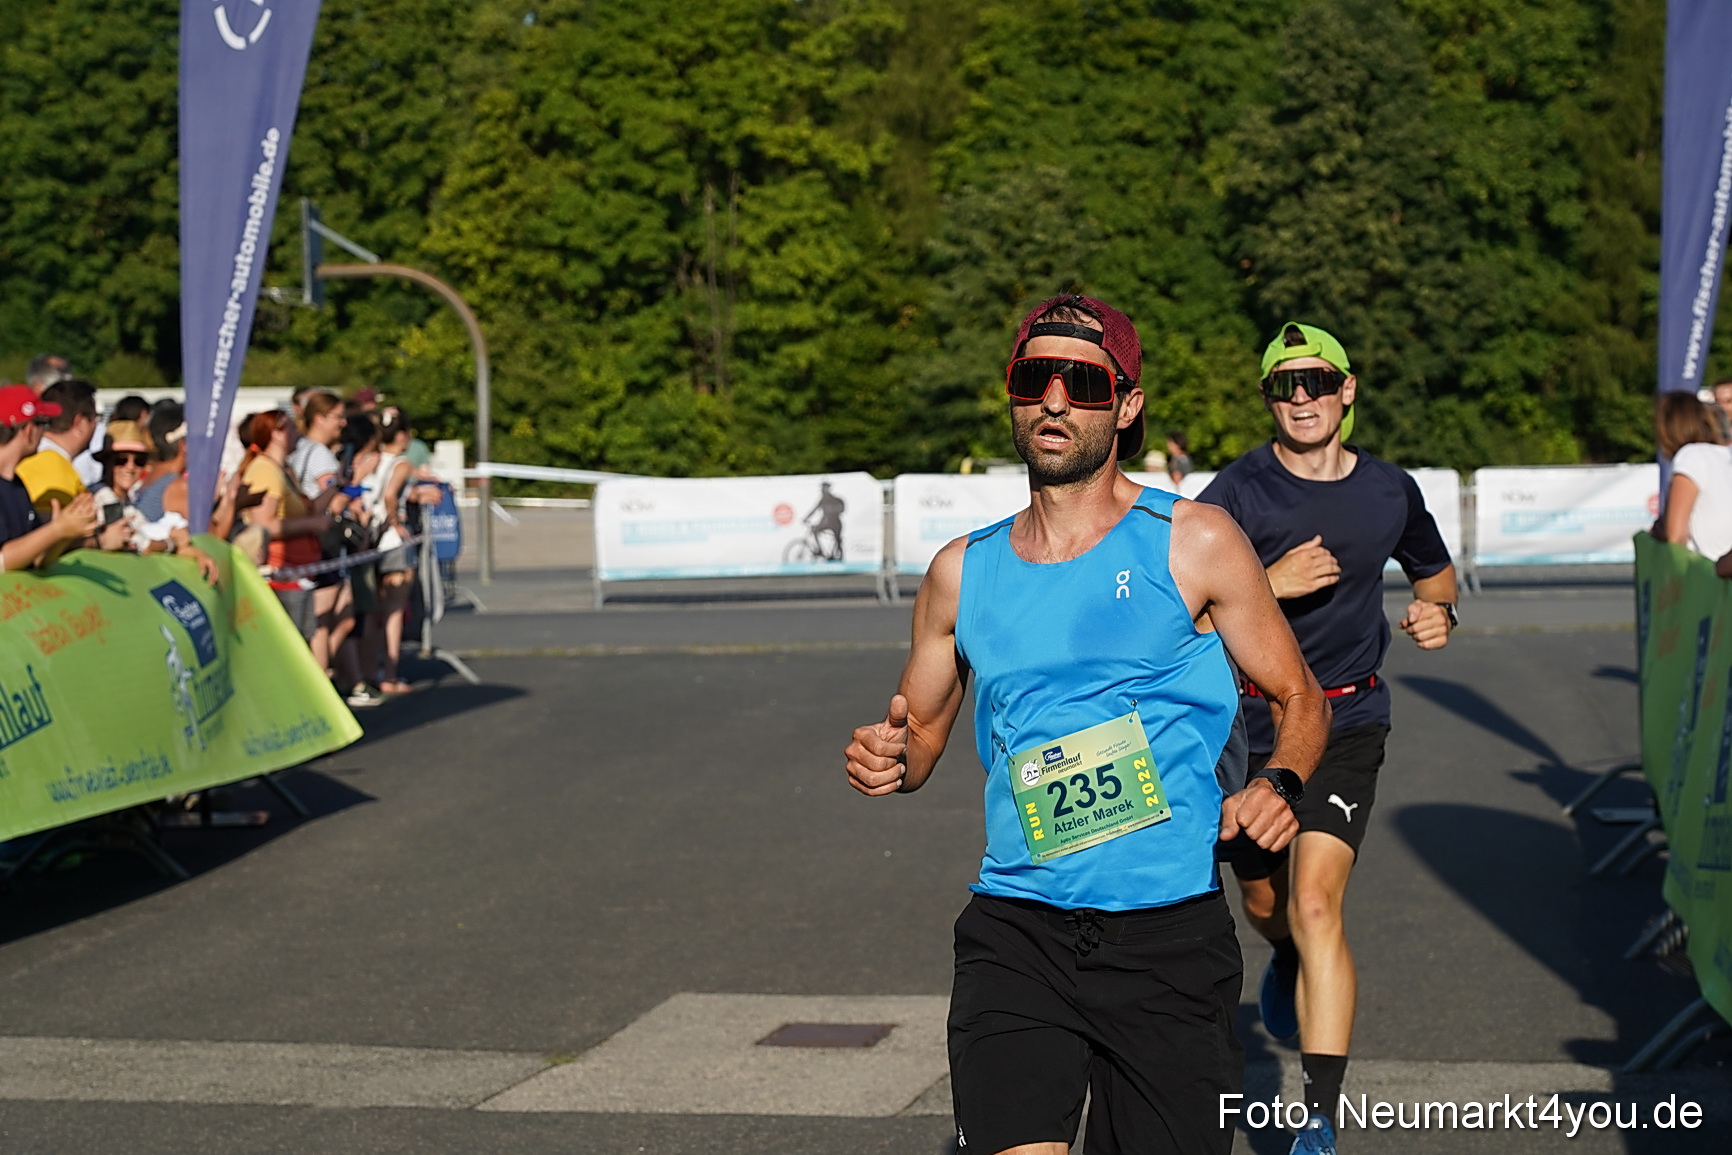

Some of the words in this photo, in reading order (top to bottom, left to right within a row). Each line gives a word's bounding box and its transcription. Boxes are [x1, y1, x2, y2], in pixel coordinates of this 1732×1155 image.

[1041, 752, 1081, 775] Firmenlauf
[1057, 761, 1083, 774] neumarkt
[1047, 763, 1122, 819] 235
[1133, 756, 1160, 808] 2022
[1025, 802, 1045, 841] RUN
[1054, 815, 1089, 835] Atzler
[1092, 799, 1135, 821] Marek
[1071, 831, 1091, 840] Services
[1091, 821, 1119, 834] Deutschland
[1119, 815, 1134, 824] GmbH
